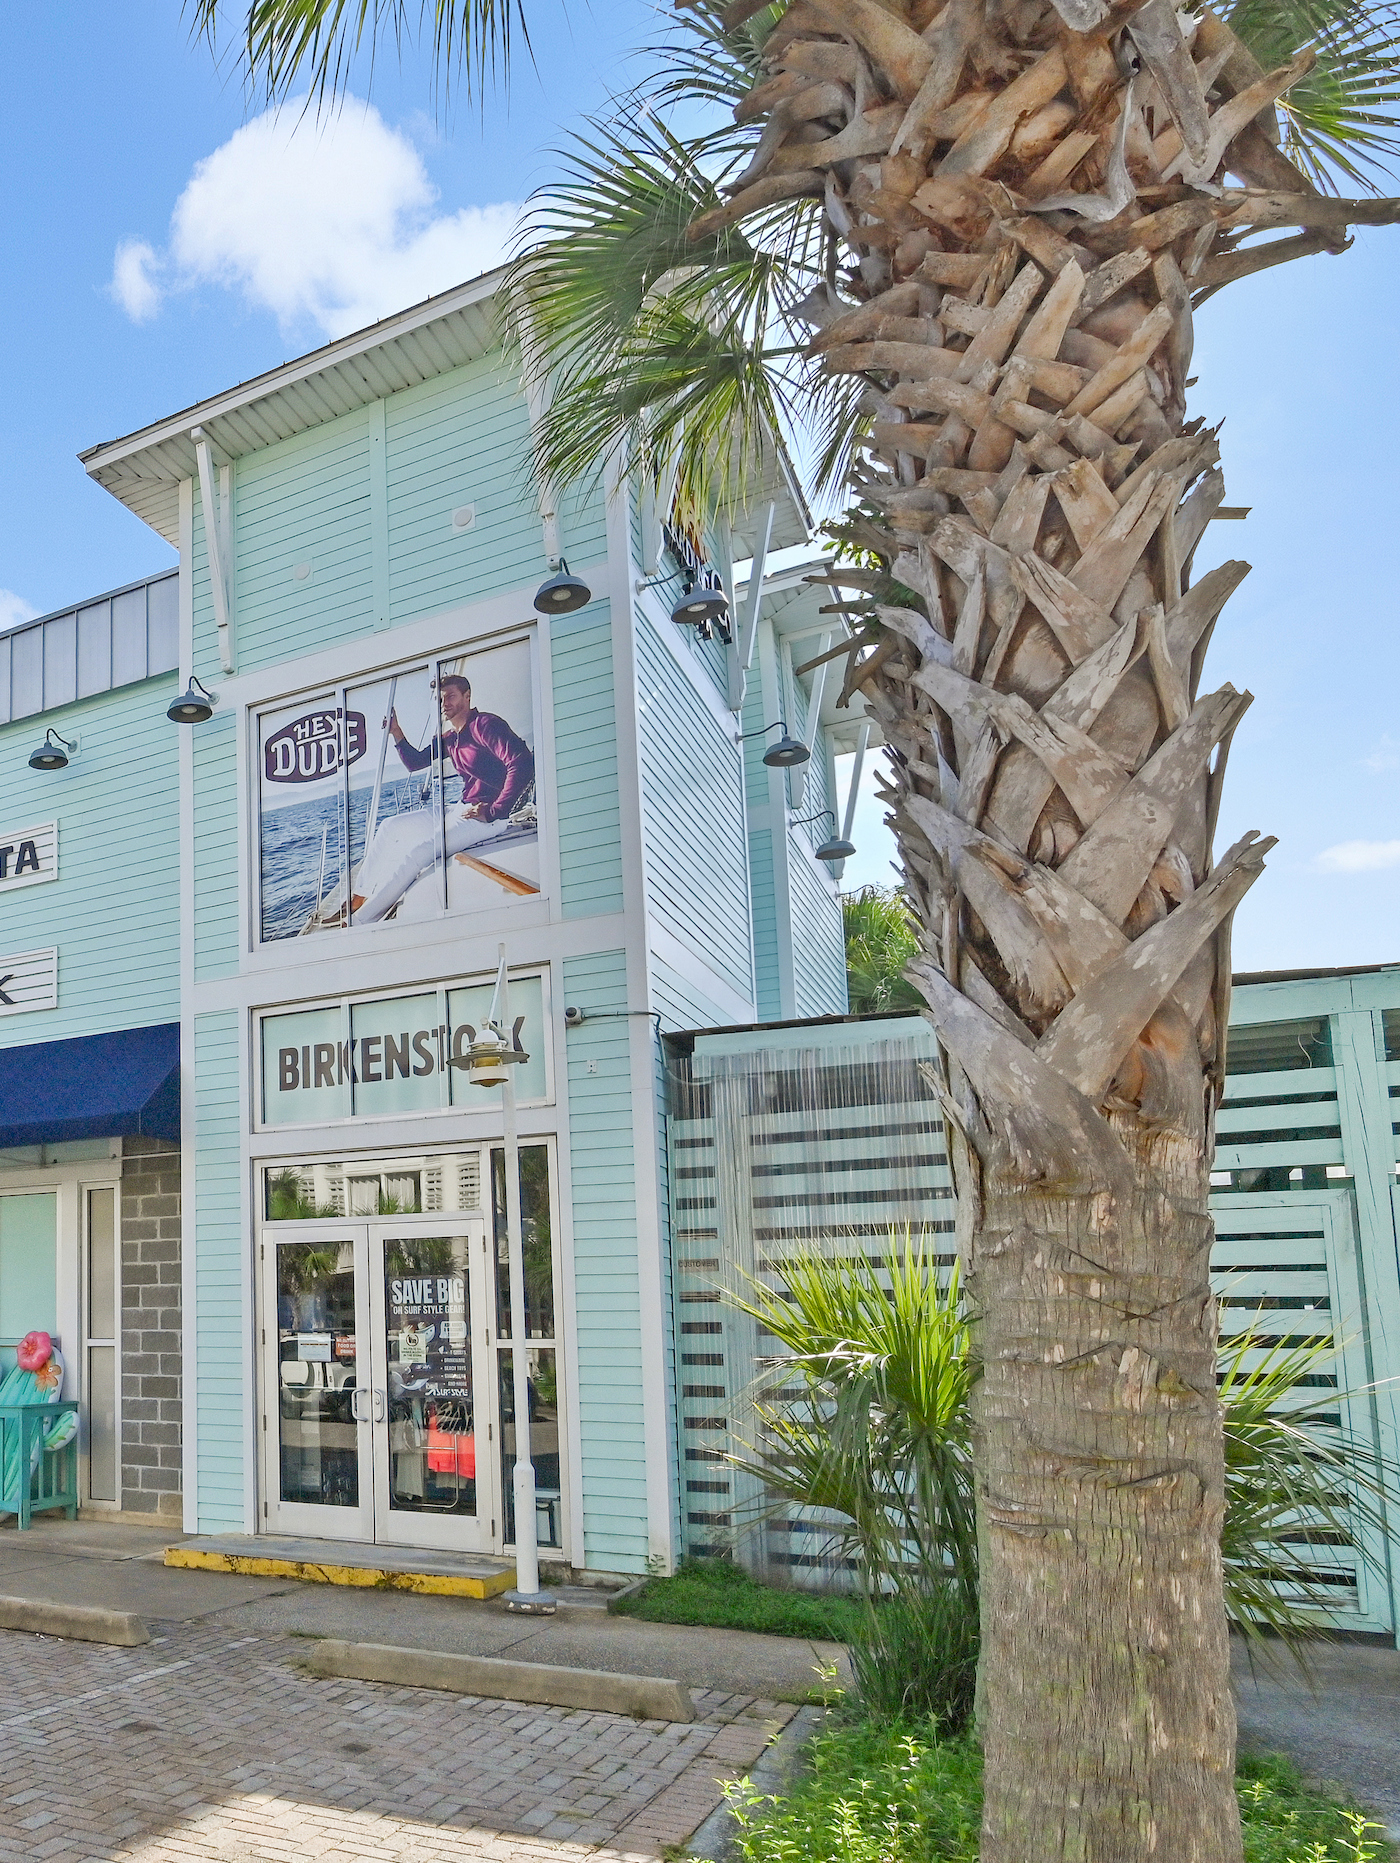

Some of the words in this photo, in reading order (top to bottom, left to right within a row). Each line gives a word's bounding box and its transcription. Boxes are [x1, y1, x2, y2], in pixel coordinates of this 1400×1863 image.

[293, 715, 338, 745] HEY
[271, 720, 359, 776] DUDE
[279, 1016, 527, 1091] BIRKENSTOK
[391, 1280, 433, 1305] SAVE
[436, 1278, 465, 1304] BIG
[393, 1305, 403, 1315] ON
[404, 1305, 421, 1315] SURF
[423, 1305, 443, 1314] STYLE
[445, 1304, 465, 1314] GEAR!
